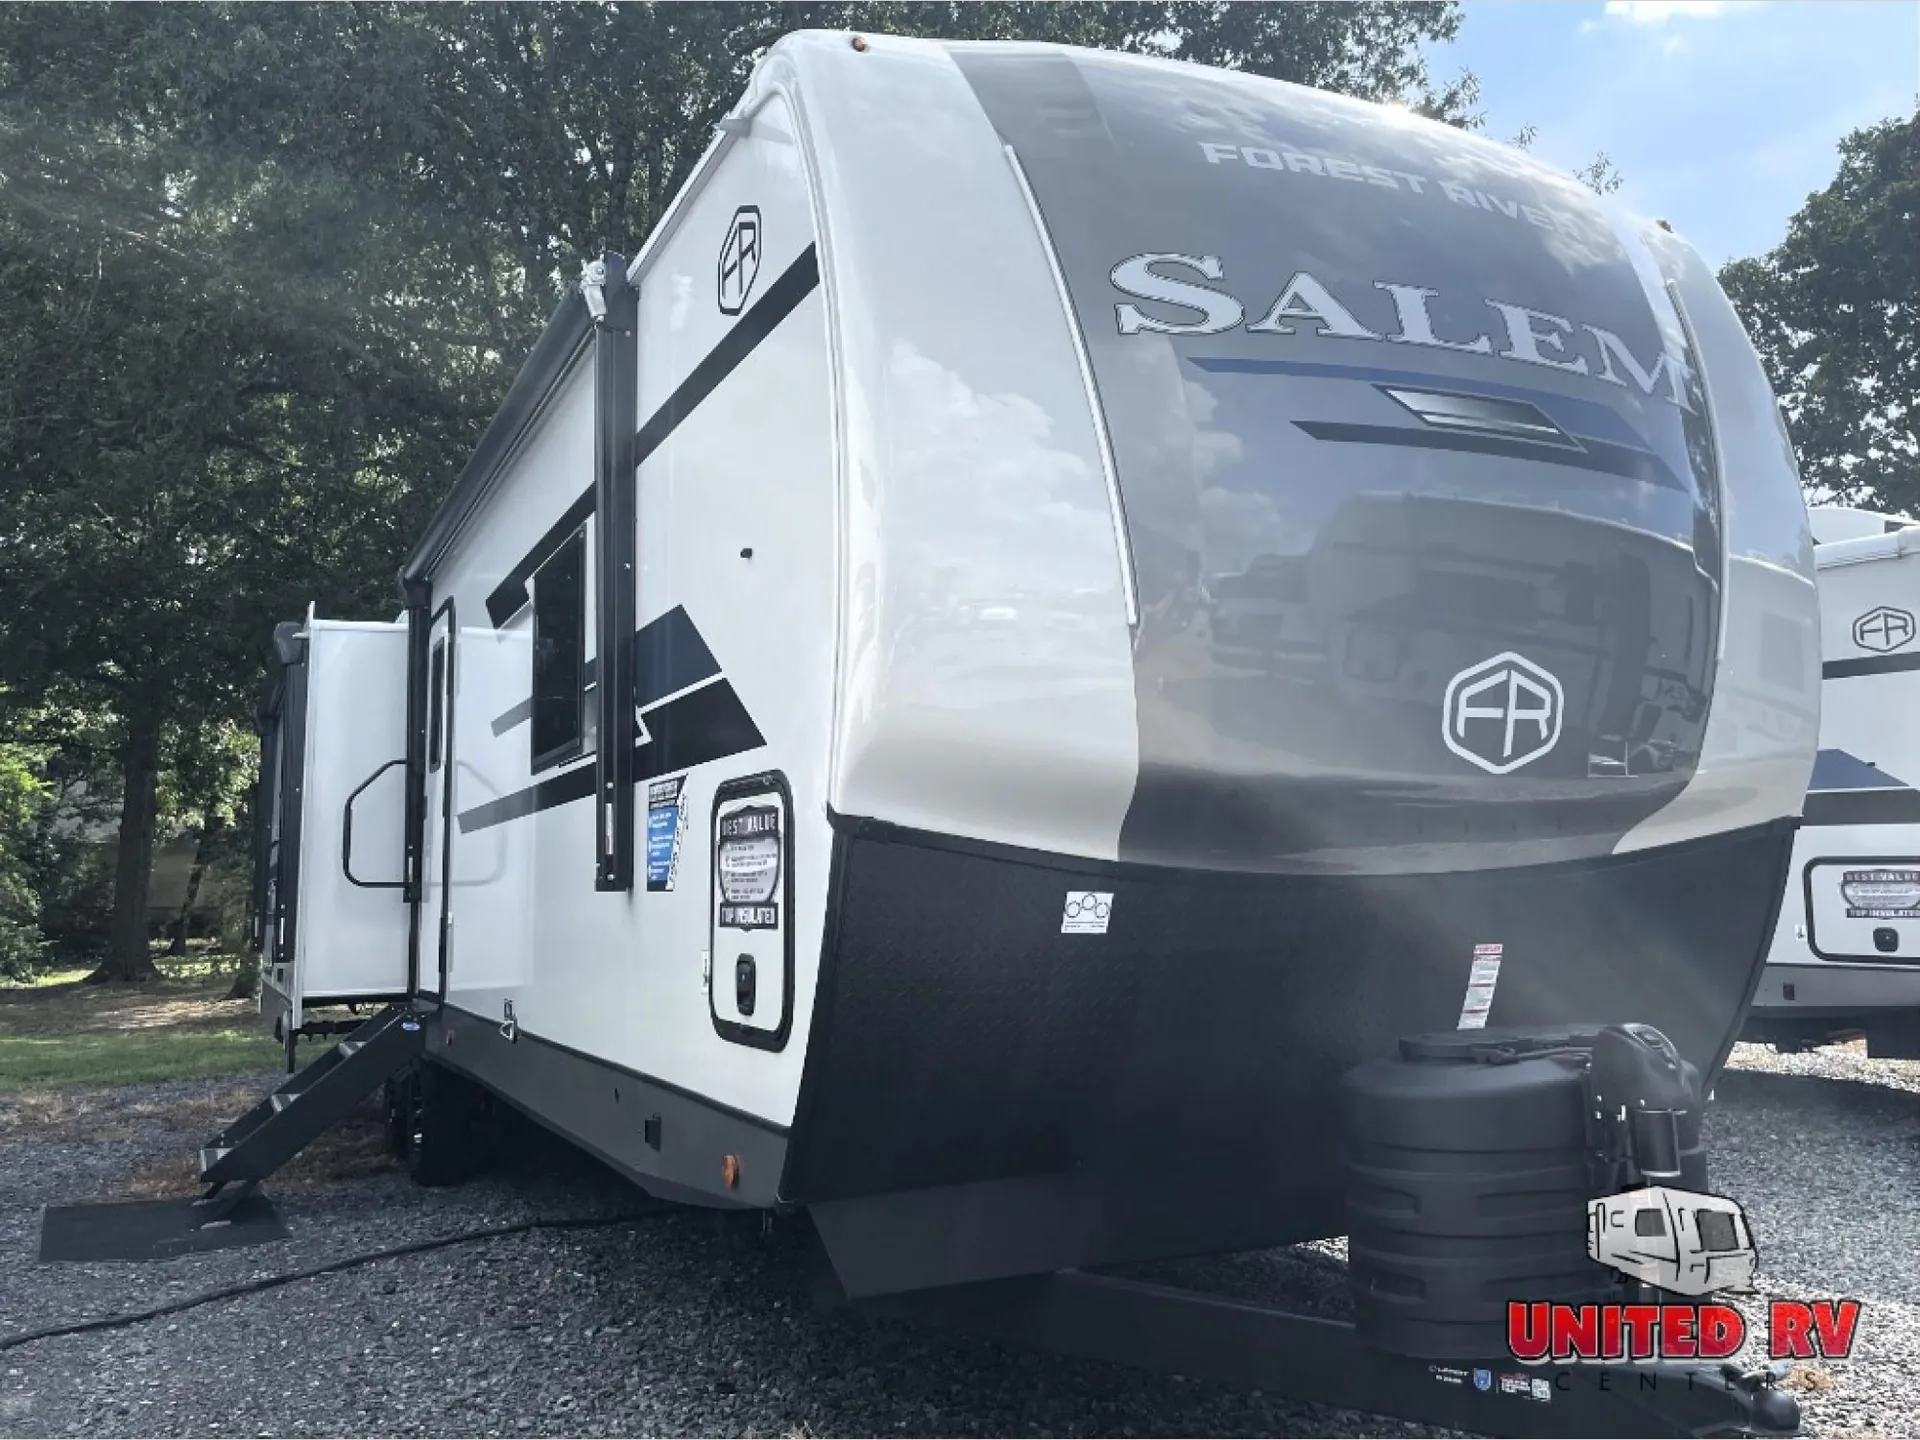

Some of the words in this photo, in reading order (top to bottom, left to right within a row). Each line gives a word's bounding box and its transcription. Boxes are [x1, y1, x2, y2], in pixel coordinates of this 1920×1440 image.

[1197, 142, 1428, 194] FOREST
[1438, 180, 1578, 238] RIVE
[1109, 251, 1699, 416] SALEM
